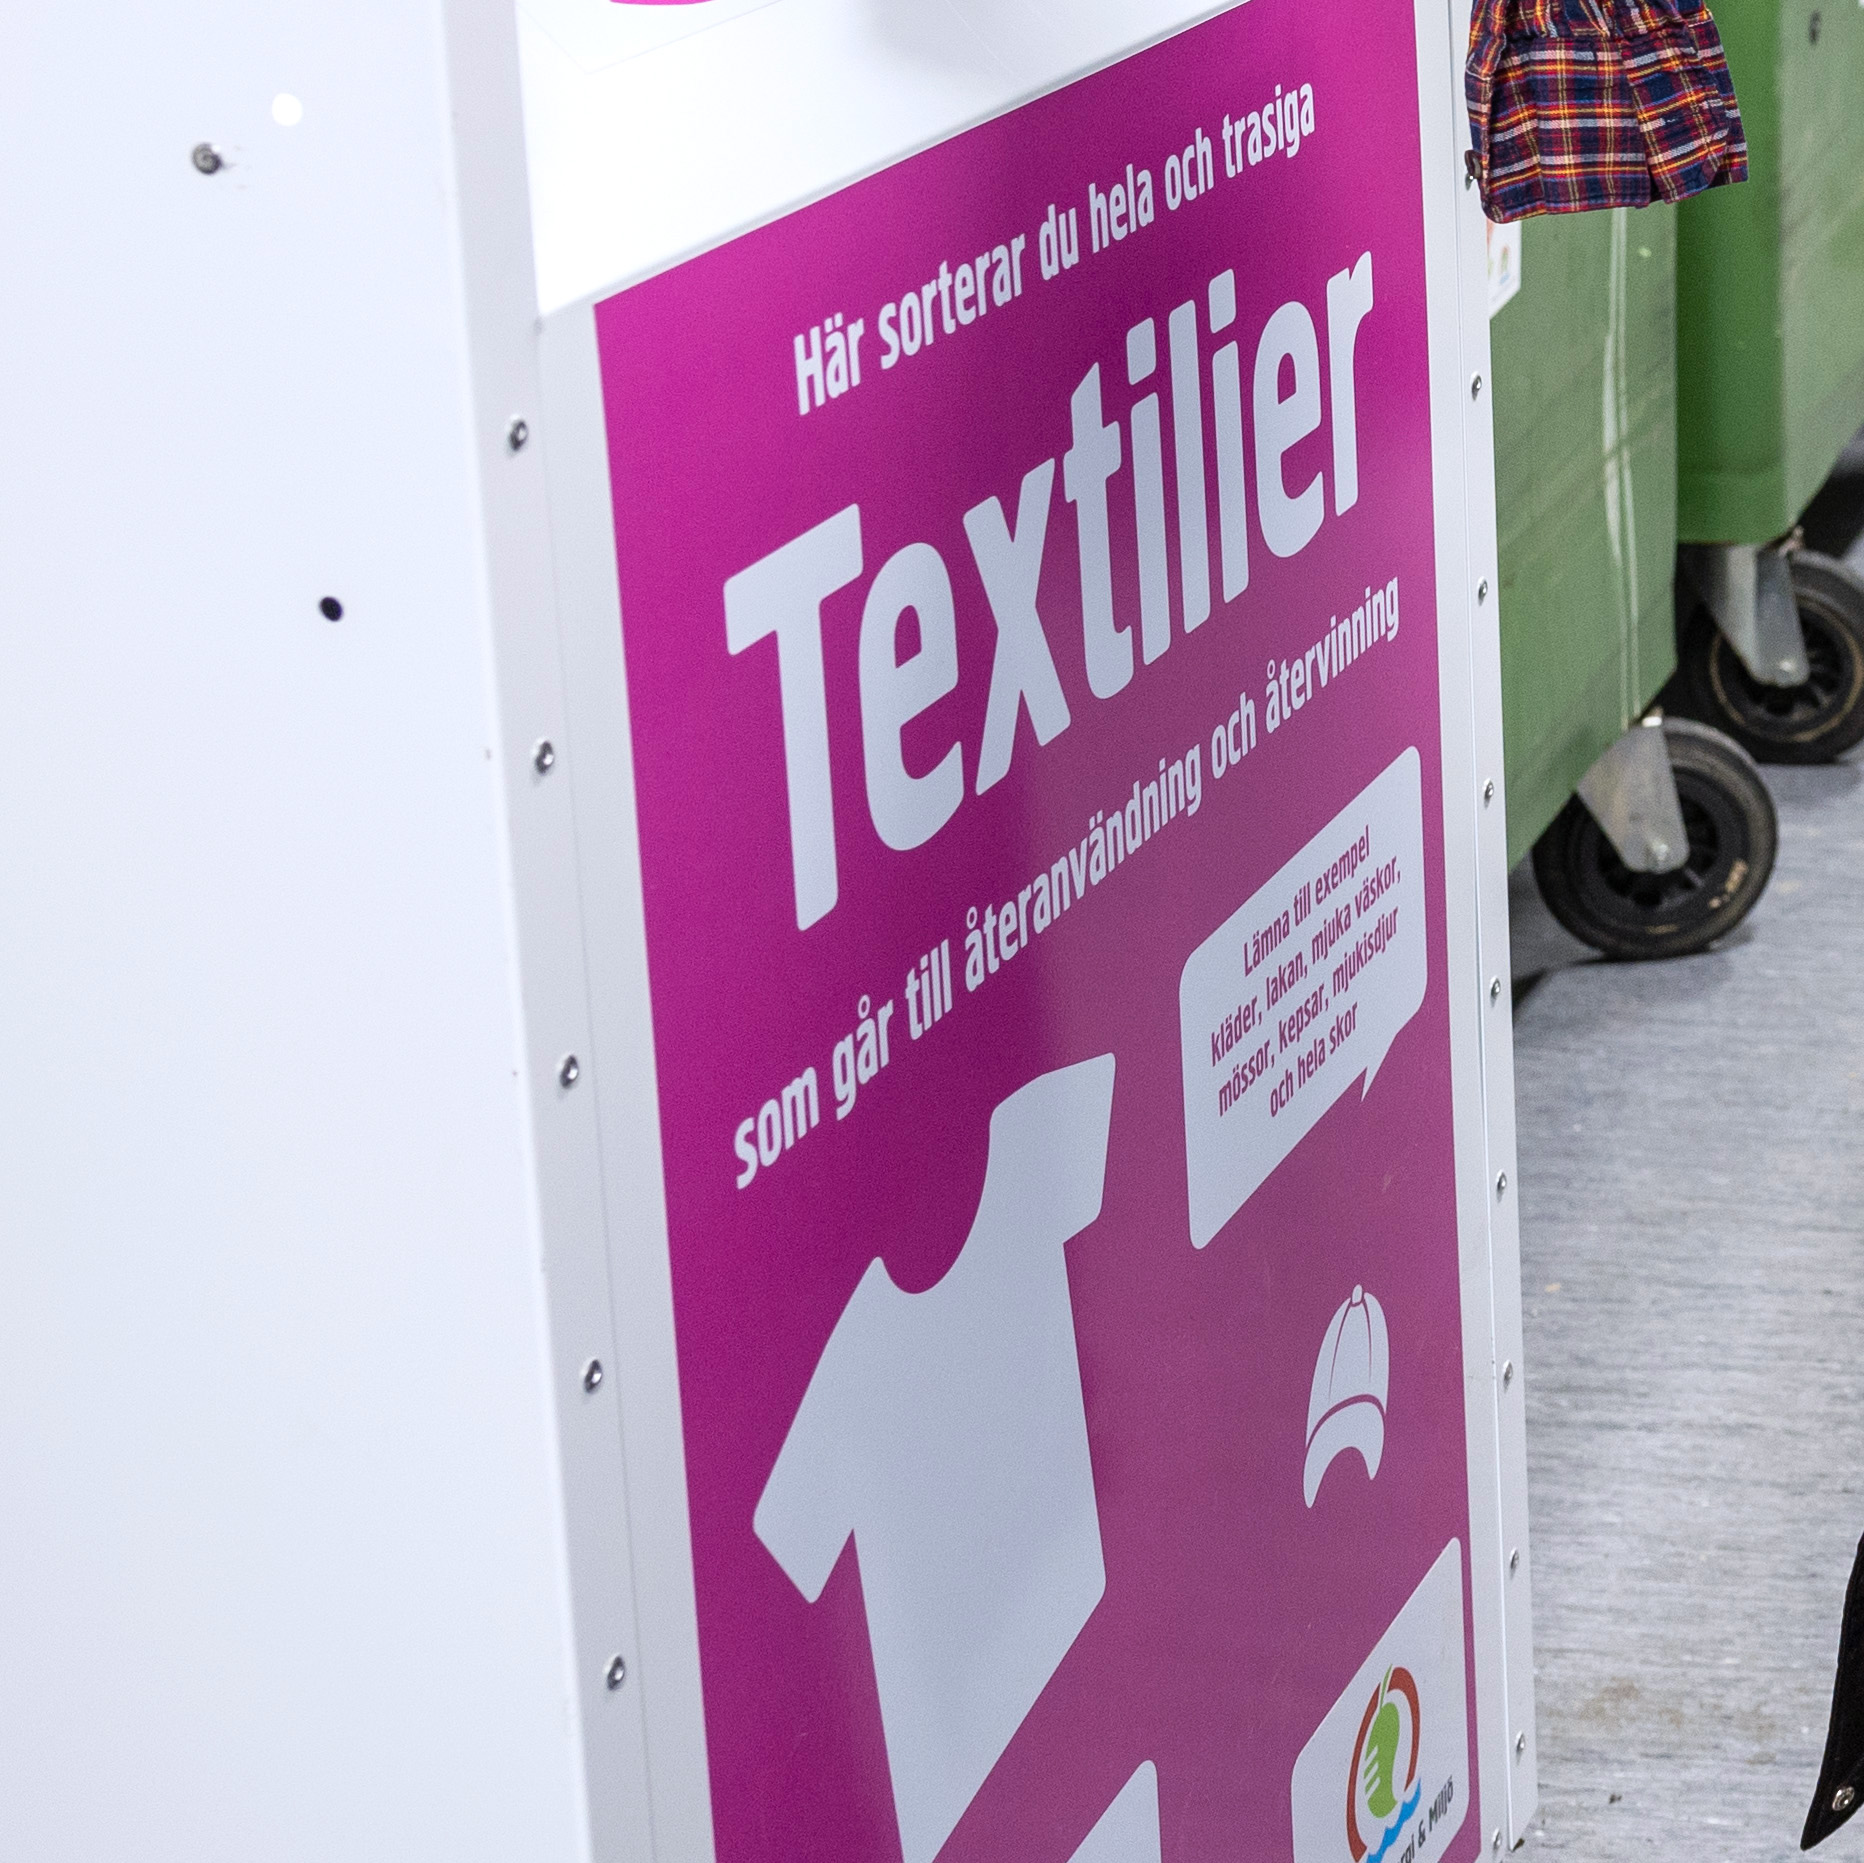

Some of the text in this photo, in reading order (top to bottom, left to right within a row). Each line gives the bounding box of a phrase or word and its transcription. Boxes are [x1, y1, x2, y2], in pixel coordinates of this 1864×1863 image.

[795, 84, 1315, 416] Här sorterar du hela och trasiga
[722, 250, 1373, 932] Textilier
[735, 577, 1401, 1190] som går till återanvändning och återvinning
[1211, 857, 1401, 1066] kläder, lakan, mjuka väskor,
[1243, 824, 1370, 976] Lämna till exempel
[1218, 907, 1399, 1116] mössor, kepsar, mjukisdjur
[1269, 1001, 1358, 1118] och hela skor
[1418, 1820, 1426, 1848] &
[1429, 1774, 1454, 1833] Miljö
